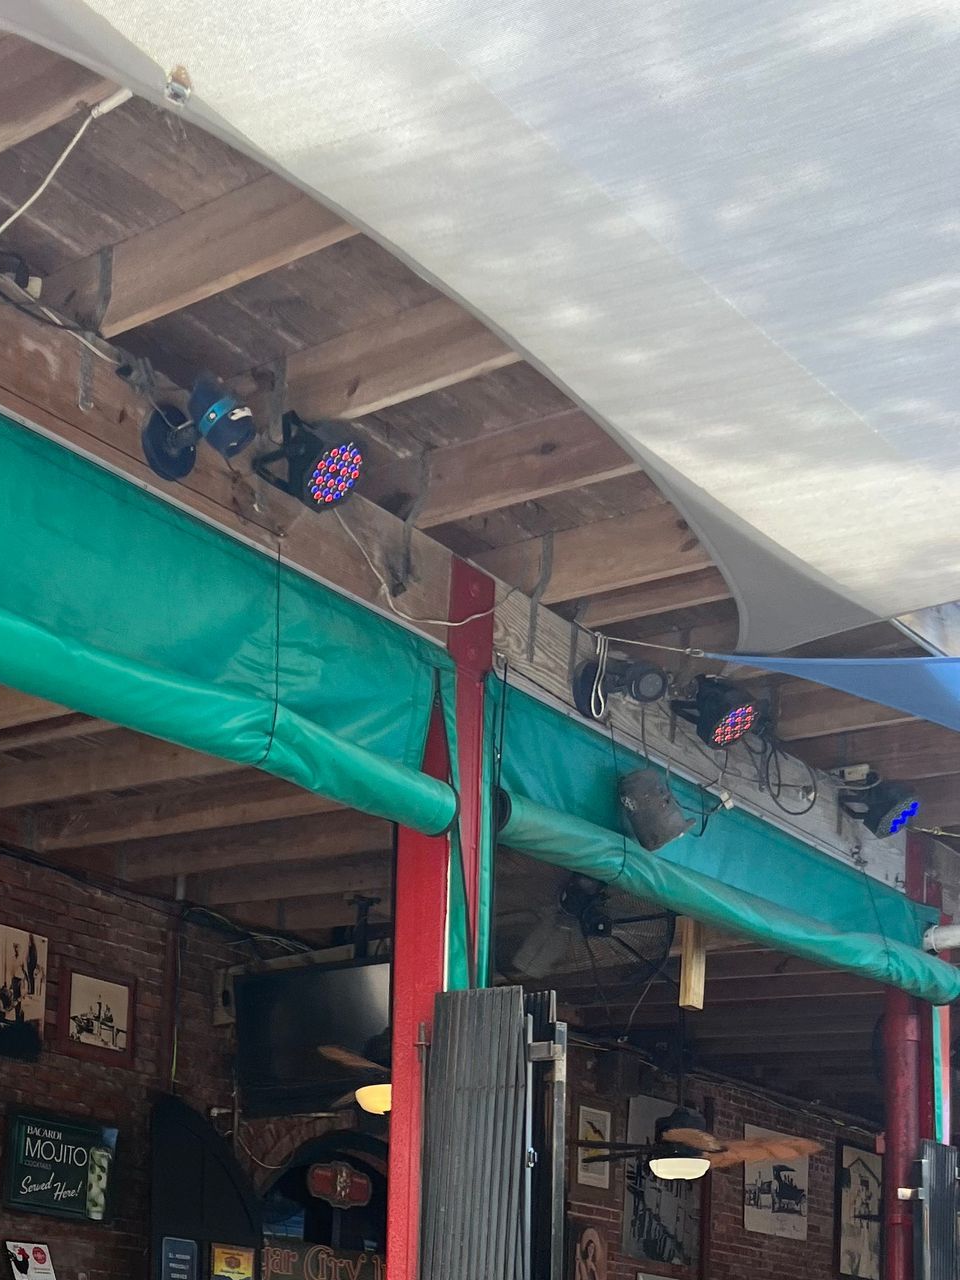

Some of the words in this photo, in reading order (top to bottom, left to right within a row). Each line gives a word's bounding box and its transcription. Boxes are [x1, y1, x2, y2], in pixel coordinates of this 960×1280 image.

[27, 1125, 63, 1140] BACARDI
[25, 1137, 88, 1167] MOJITO
[20, 1172, 55, 1194] Served
[53, 1180, 83, 1200] Here!
